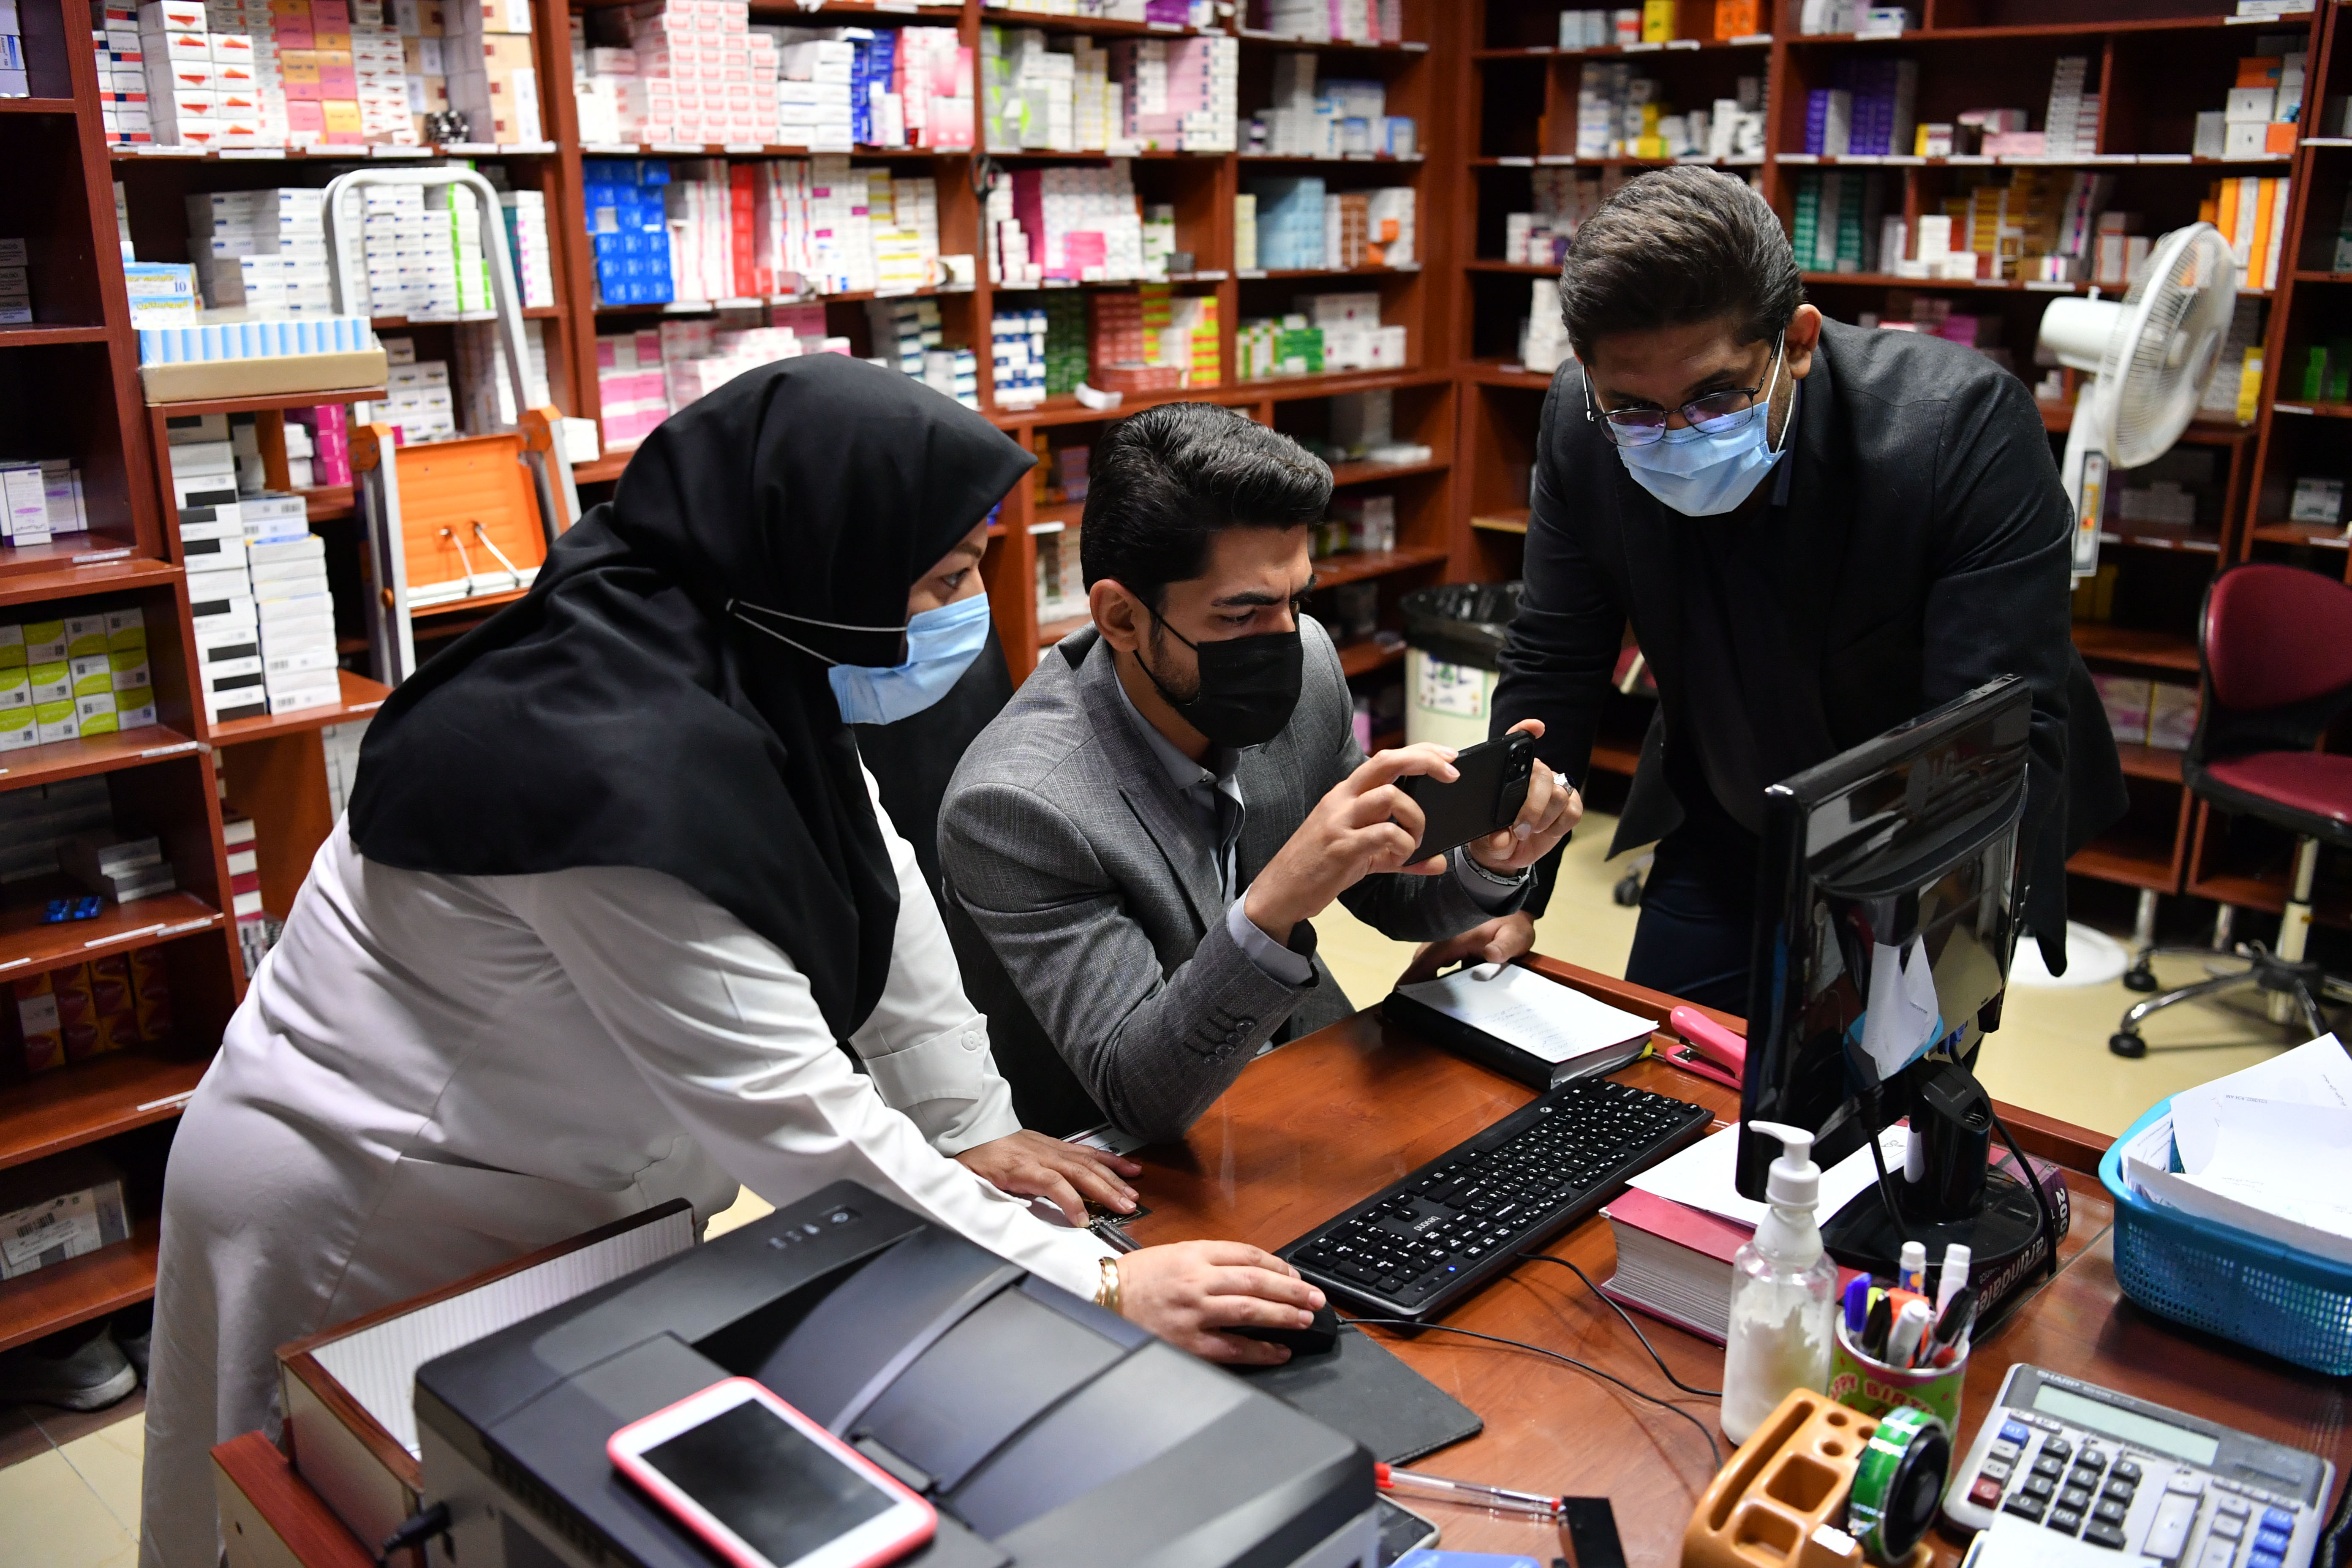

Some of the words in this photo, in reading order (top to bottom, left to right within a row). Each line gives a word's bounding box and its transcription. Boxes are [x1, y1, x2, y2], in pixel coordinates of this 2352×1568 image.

[175, 281, 186, 292] 10
[1413, 1216, 1441, 1231] beyond
[1978, 1236, 2044, 1312] artindale
[2037, 1370, 2080, 1387] SHARP
[2052, 1440, 2063, 1448] 7
[2086, 1451, 2096, 1460] 8
[2121, 1463, 2133, 1472] 9
[2042, 1459, 2053, 1469] 4
[2078, 1471, 2088, 1481] 5
[2113, 1482, 2124, 1491] 6
[2019, 1498, 2031, 1506] 0
[2055, 1509, 2077, 1519] 00
[2069, 1491, 2081, 1500] 2
[2105, 1503, 2115, 1513] 3
